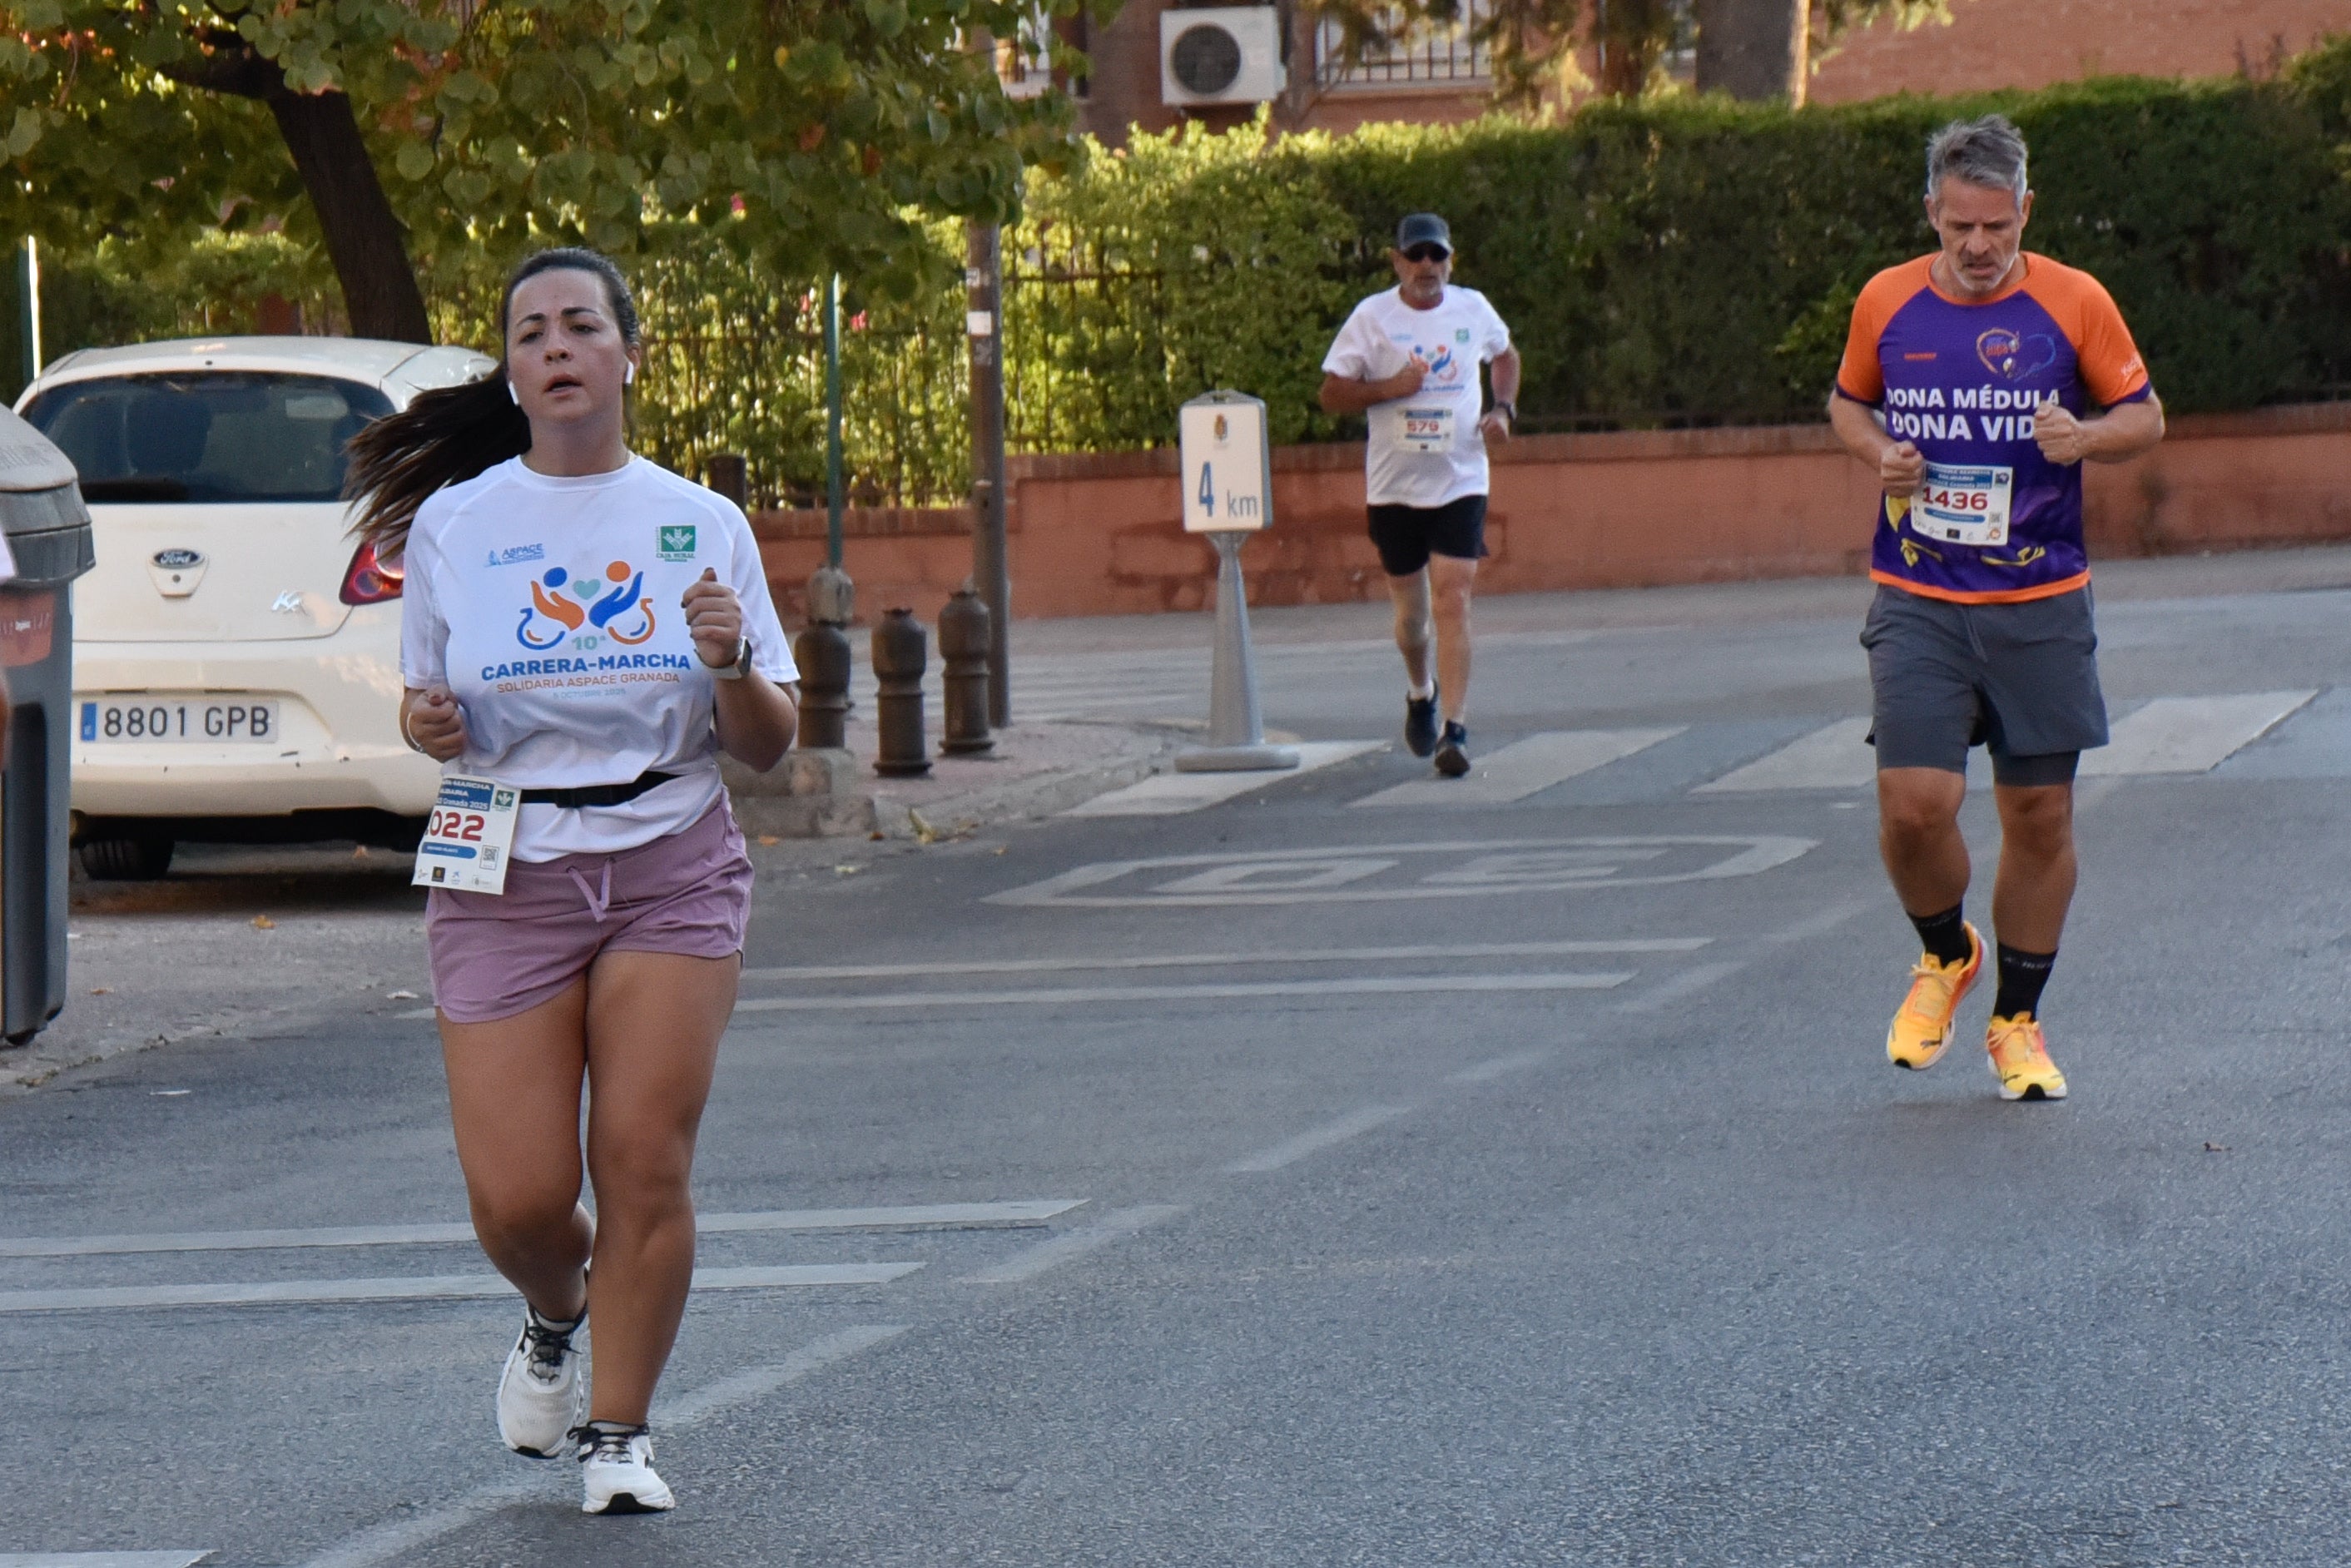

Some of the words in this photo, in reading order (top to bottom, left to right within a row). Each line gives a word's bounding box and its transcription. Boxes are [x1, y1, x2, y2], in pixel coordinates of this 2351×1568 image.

[1892, 411, 1972, 441] DONA
[1981, 415, 2036, 442] VID
[1198, 461, 1214, 518] 4
[1227, 489, 1257, 518] km
[1922, 486, 1988, 511] 1436
[160, 551, 191, 564] Ford
[501, 543, 543, 559] ASPACE
[481, 653, 692, 681] CARRERA-MARCHA
[497, 678, 564, 694] SOLIDARIA
[567, 674, 617, 689] ASPACE
[620, 672, 681, 684] GRANADA
[104, 707, 186, 737] 8801
[205, 706, 269, 737] GPB
[424, 810, 485, 842] 022
